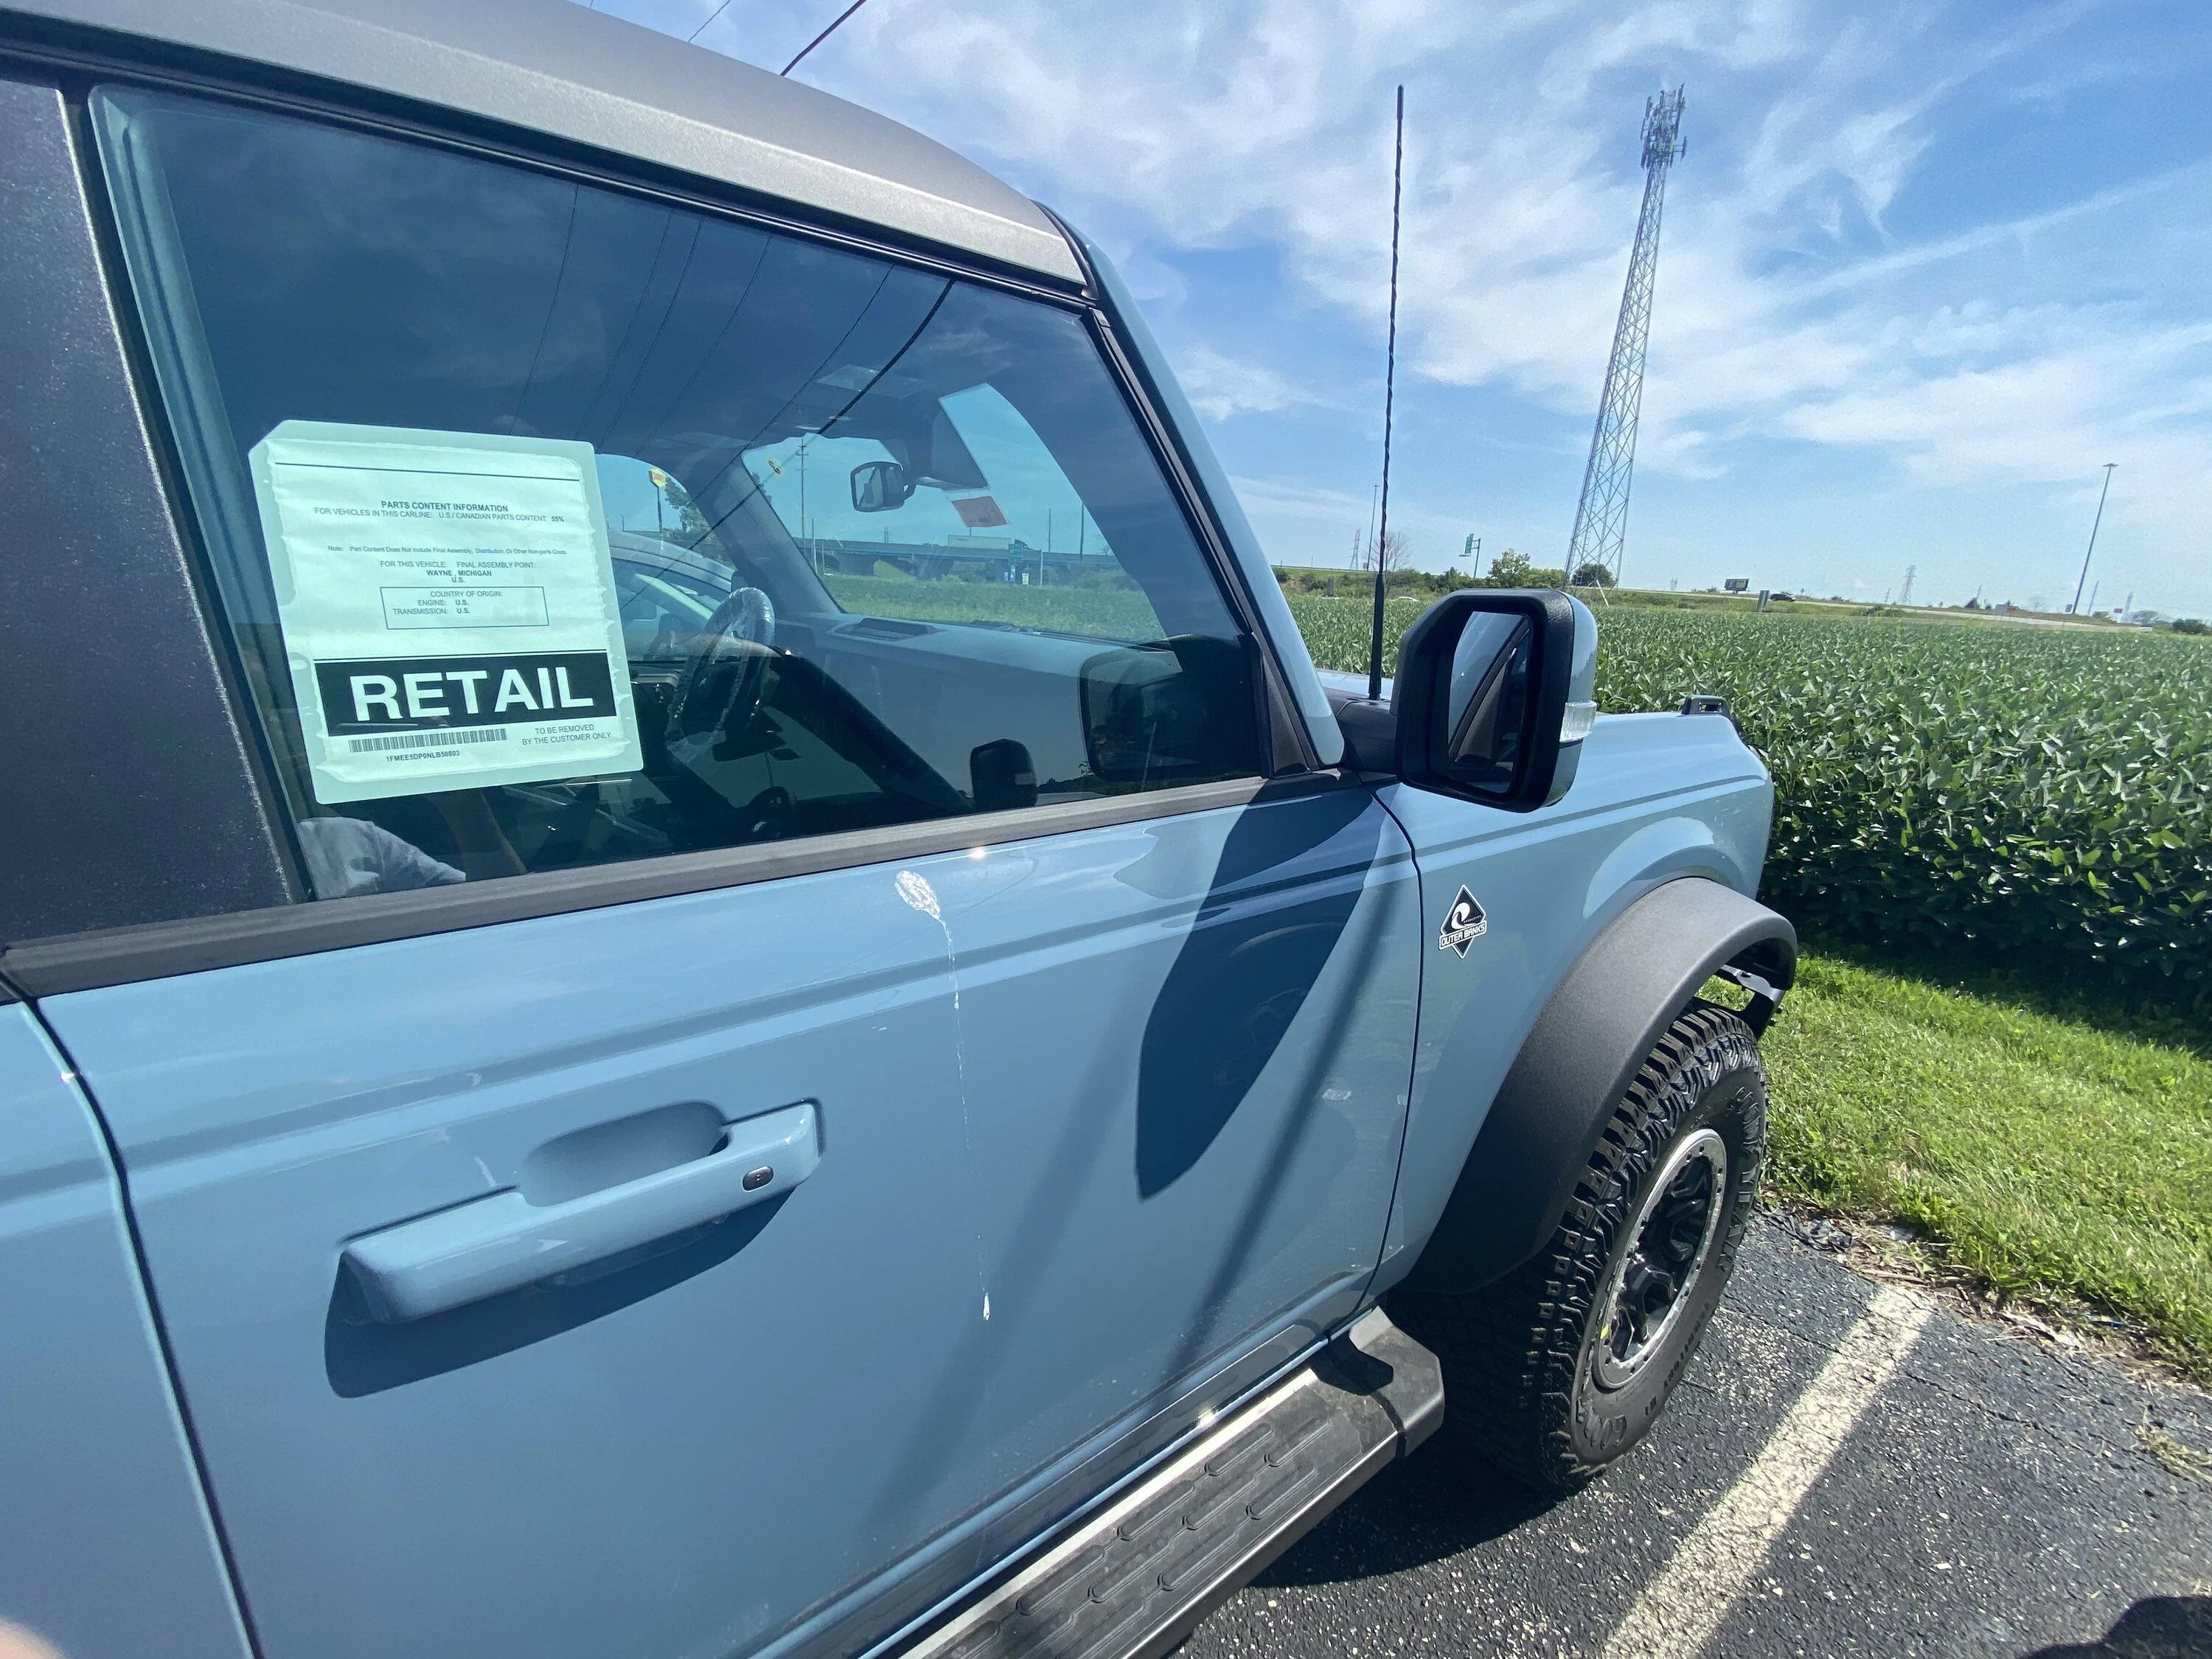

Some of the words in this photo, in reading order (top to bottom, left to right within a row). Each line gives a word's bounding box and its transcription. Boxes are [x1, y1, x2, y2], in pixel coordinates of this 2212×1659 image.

[333, 508, 371, 516] VEHICLES
[381, 501, 410, 509] PARTS
[412, 502, 451, 510] CONTENT
[453, 503, 508, 512] INFORMATION
[349, 667, 594, 722] RETAIL
[535, 727, 546, 735] TO
[547, 726, 557, 734] BE
[559, 723, 594, 733] REMOVED
[550, 733, 591, 743] CUSTOMER
[592, 731, 611, 740] ONLY
[1441, 932, 1463, 946] OUTER
[1464, 924, 1485, 938] BANKS
